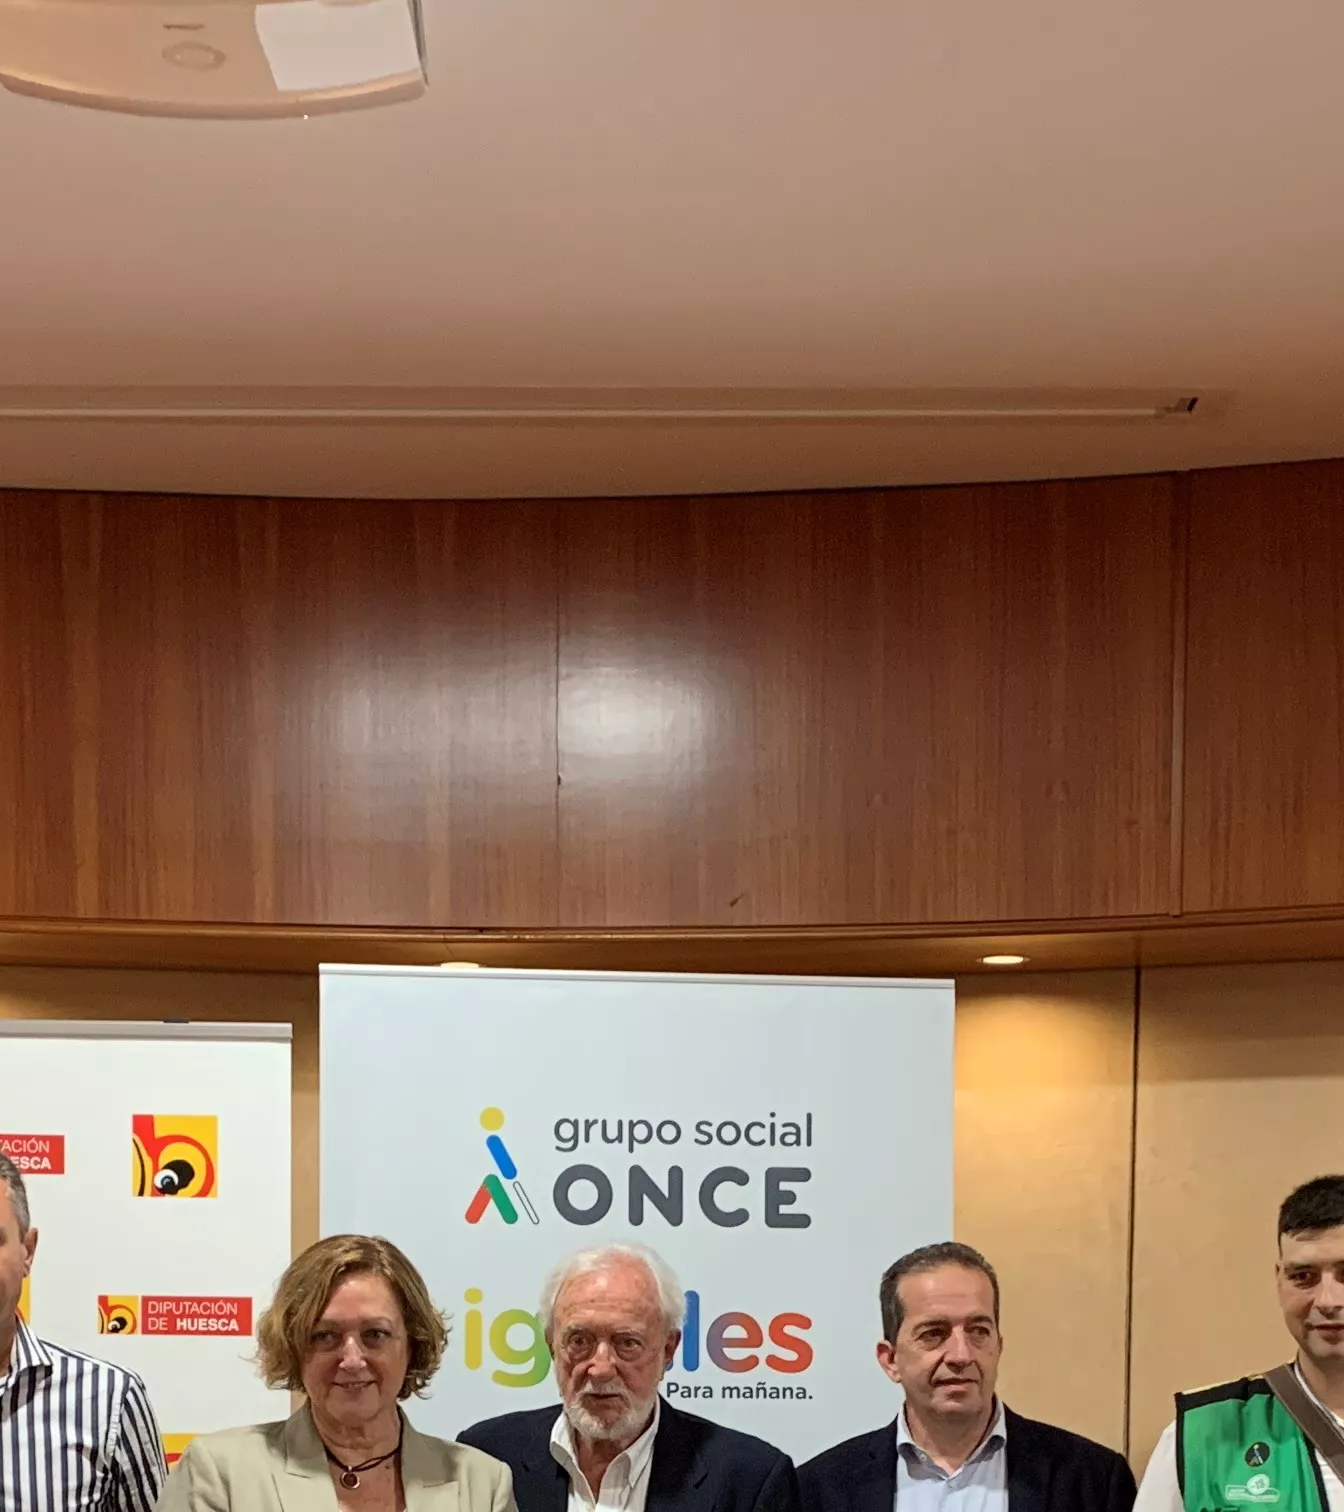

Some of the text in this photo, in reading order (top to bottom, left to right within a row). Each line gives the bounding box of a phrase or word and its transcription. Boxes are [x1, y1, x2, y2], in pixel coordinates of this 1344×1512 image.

[554, 1112, 812, 1152] grupo social
[10, 1157, 51, 1169] ESCA
[553, 1164, 812, 1228] ONCE
[148, 1300, 238, 1316] DIPUTACIÓN
[148, 1318, 239, 1332] DE HUESCA
[464, 1288, 814, 1388] igles
[666, 1380, 813, 1400] Para mañana.
